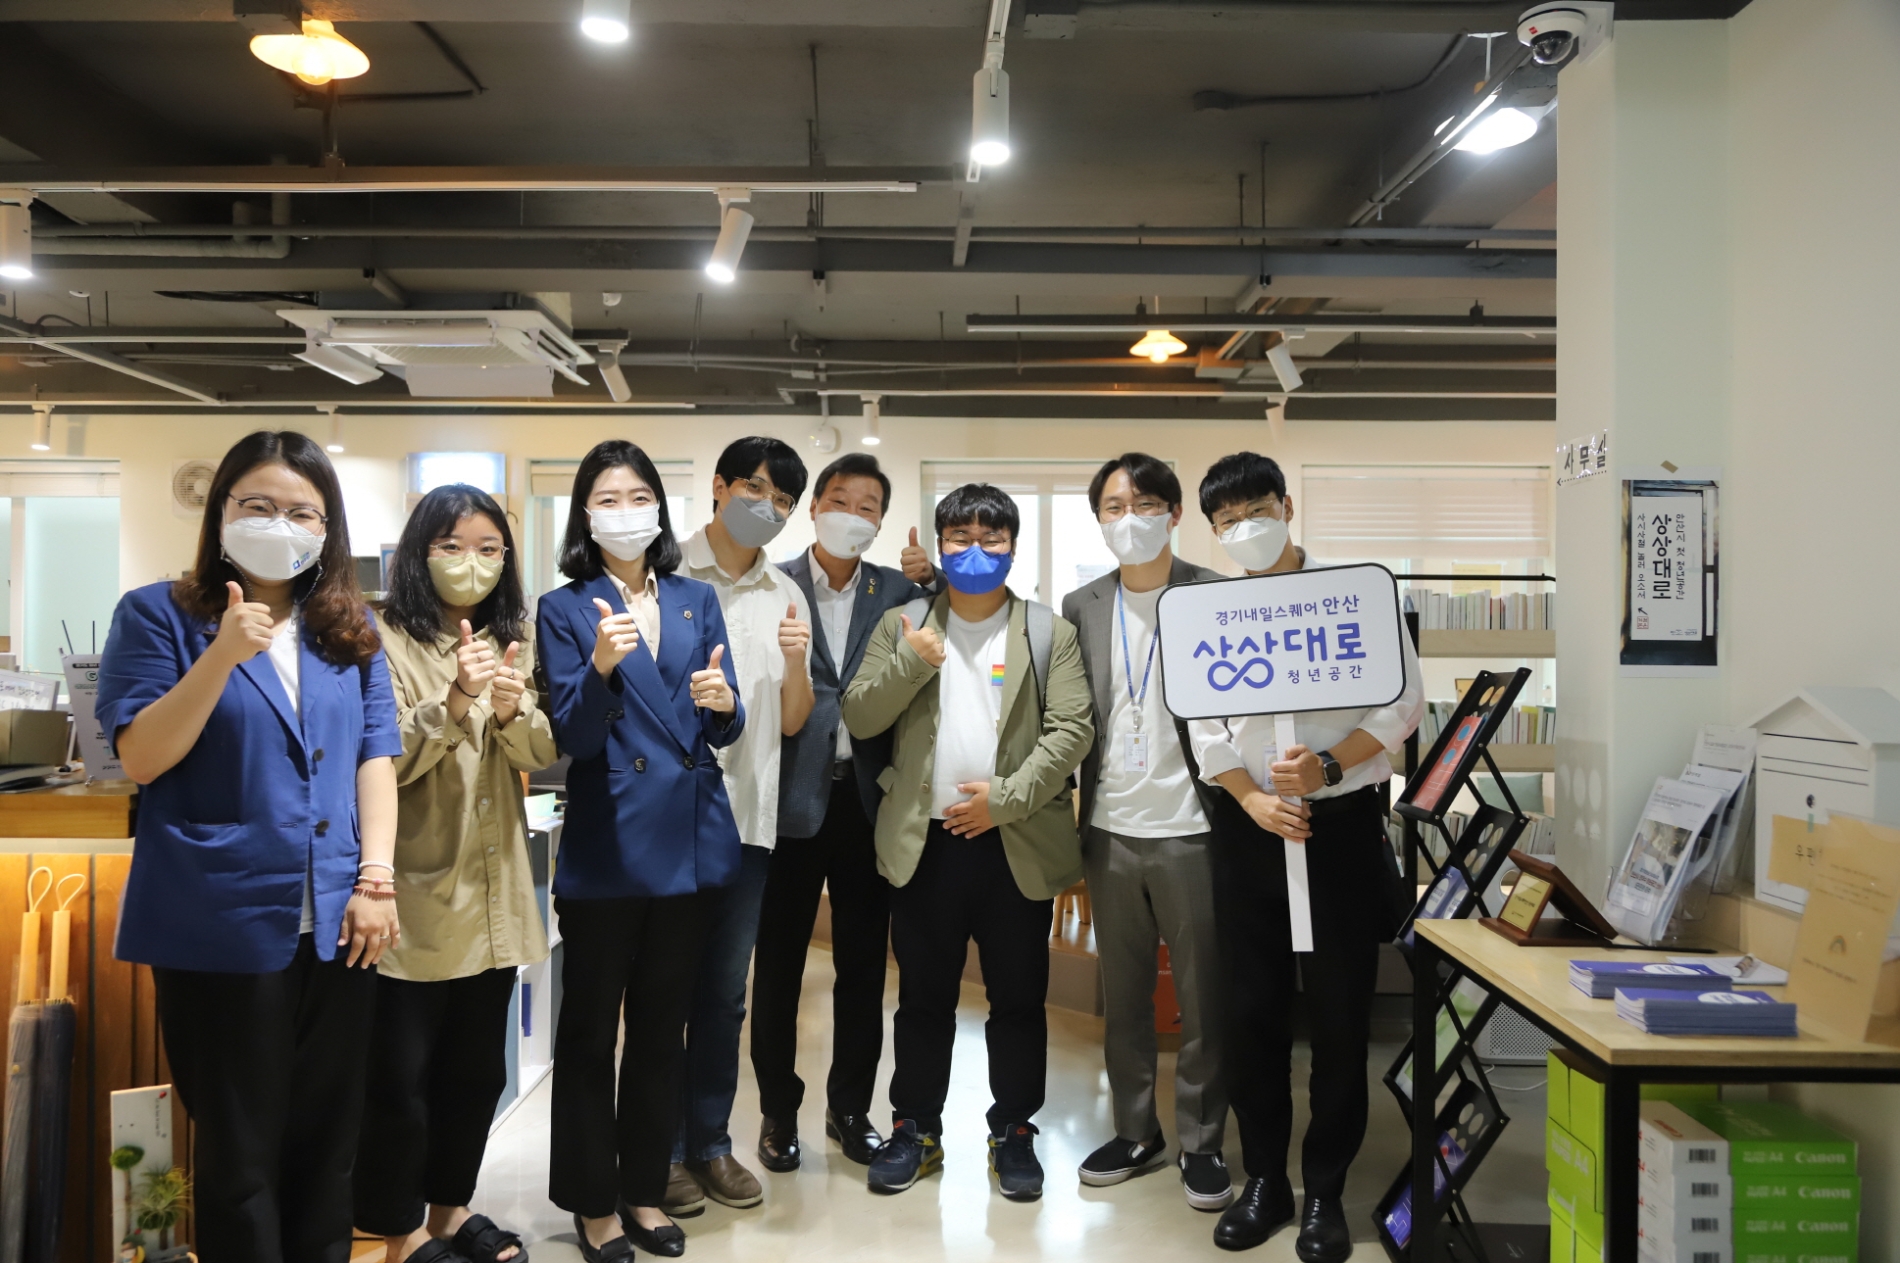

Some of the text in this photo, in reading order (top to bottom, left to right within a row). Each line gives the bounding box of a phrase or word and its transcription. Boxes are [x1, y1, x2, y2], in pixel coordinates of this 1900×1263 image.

[1564, 433, 1607, 475] 사무실
[1675, 513, 1686, 543] 안산시
[1652, 513, 1672, 599] 상상대로
[1637, 573, 1646, 599] 오소서
[1675, 560, 1686, 600] 청년공간
[1215, 594, 1360, 626] 경기내일스퀘어 안산
[1193, 622, 1367, 691] 상상대로
[1794, 1151, 1846, 1164] Canon
[1798, 1185, 1851, 1199] Canon
[1797, 1220, 1849, 1233] Canon
